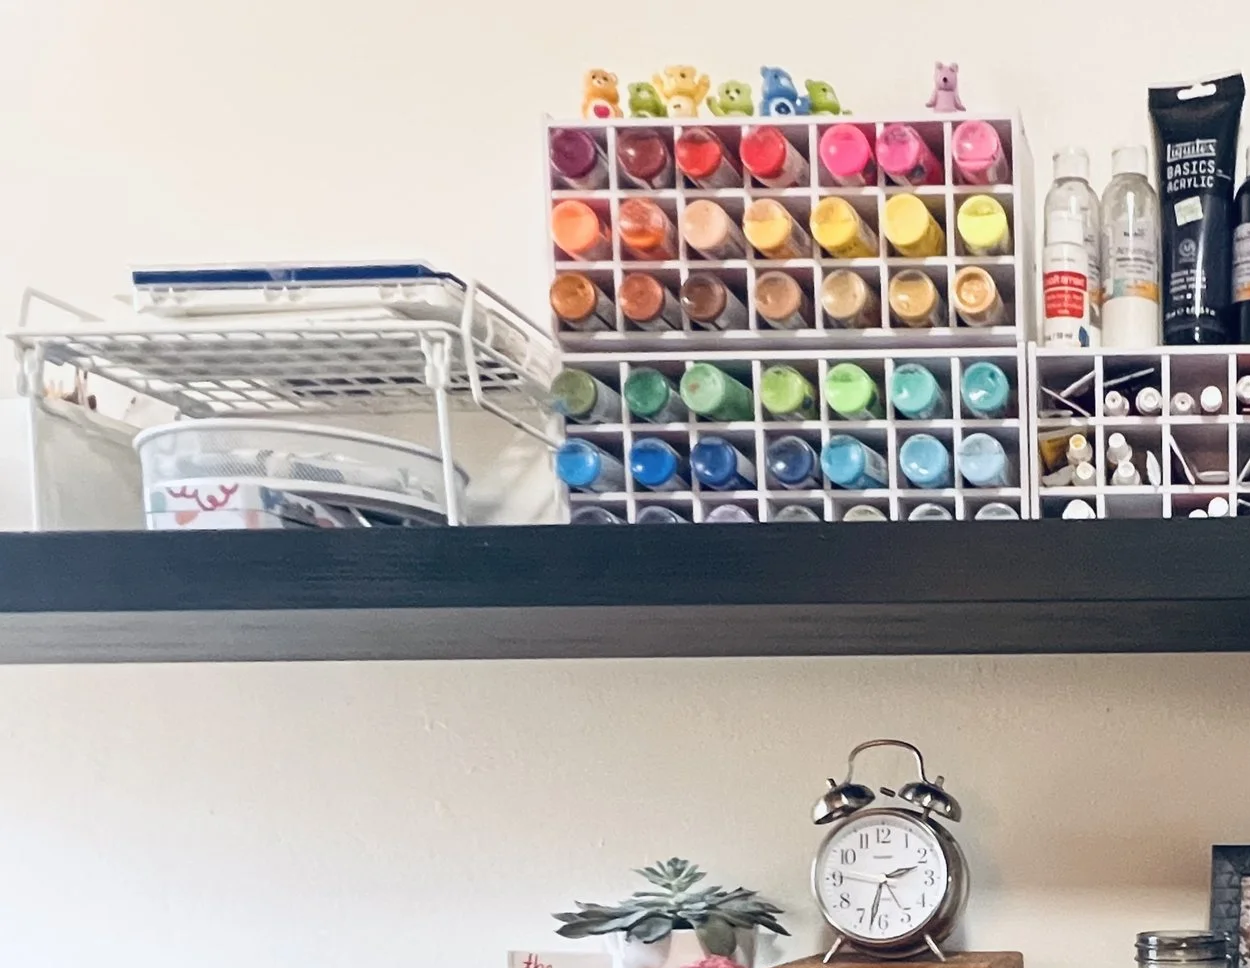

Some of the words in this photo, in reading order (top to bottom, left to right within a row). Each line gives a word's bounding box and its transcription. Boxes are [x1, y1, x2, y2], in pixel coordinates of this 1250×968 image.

[1167, 160, 1215, 180] BASICS
[1167, 176, 1214, 193] ACRYLIC
[859, 833, 869, 849] 11
[876, 828, 891, 844] 12
[905, 833, 909, 848] 1
[840, 849, 856, 865] 10
[917, 848, 928, 864] 2
[832, 871, 843, 887] 9
[924, 870, 935, 886] 3
[839, 892, 851, 909] 8
[916, 893, 926, 908] 4
[856, 908, 865, 923] 7
[878, 914, 889, 930] 6
[900, 907, 912, 923] 5
